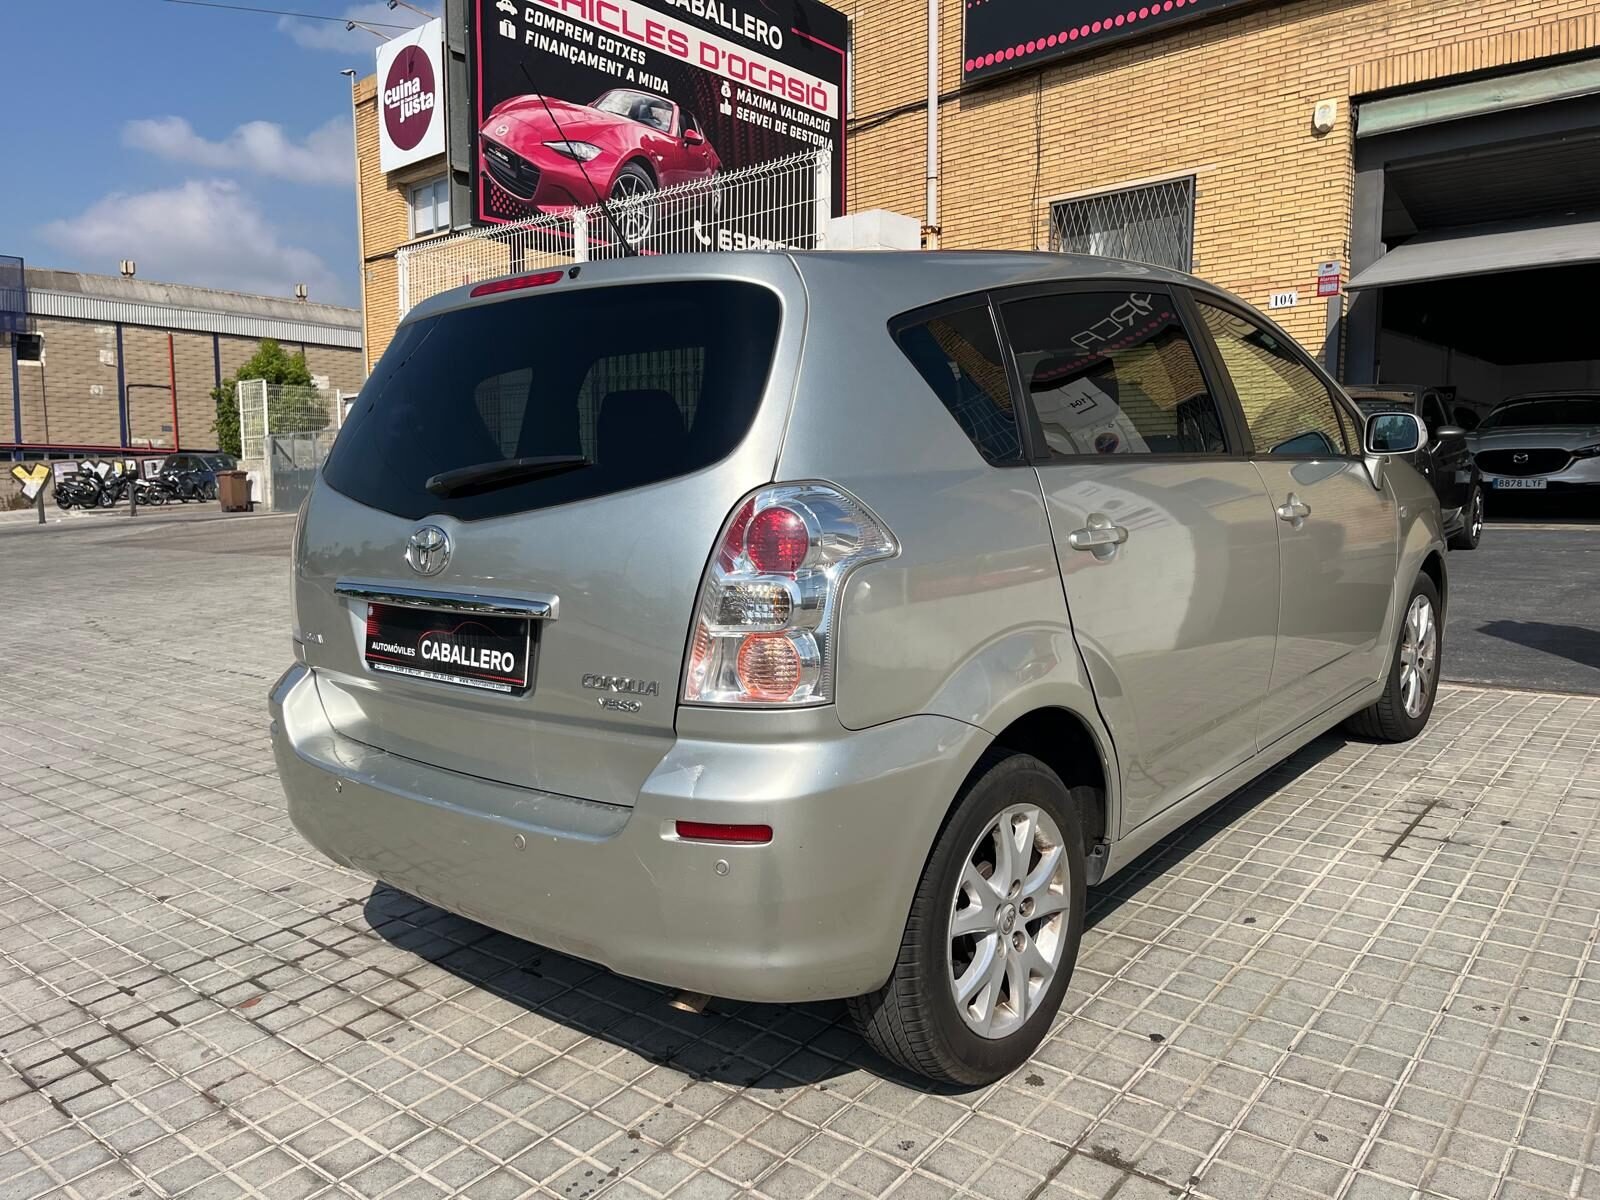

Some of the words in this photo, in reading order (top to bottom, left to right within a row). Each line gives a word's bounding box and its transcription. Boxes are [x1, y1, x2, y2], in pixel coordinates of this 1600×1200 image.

[525, 7, 594, 46] COMPREM
[597, 35, 646, 65] COTXES
[525, 30, 624, 78] FINANÇAMENT
[626, 67, 635, 82] A
[638, 71, 669, 94] MIDA
[700, 41, 828, 112] D'OCASIÓ
[384, 77, 420, 105] cuina
[400, 91, 433, 123] justa
[736, 88, 777, 114] MÀXIMA
[780, 104, 831, 133] VALORACIÓ
[736, 106, 772, 130] SERVEI
[774, 119, 787, 135] DE
[790, 124, 833, 151] GESTORIA
[1275, 294, 1293, 306] 104
[1499, 479, 1522, 488] 8878
[1525, 479, 1543, 488] LYF
[372, 641, 415, 656] AUTOMÓVILES
[421, 639, 515, 672] CABALLERO
[582, 673, 659, 696] COROLLA
[597, 697, 641, 713] VERSO
